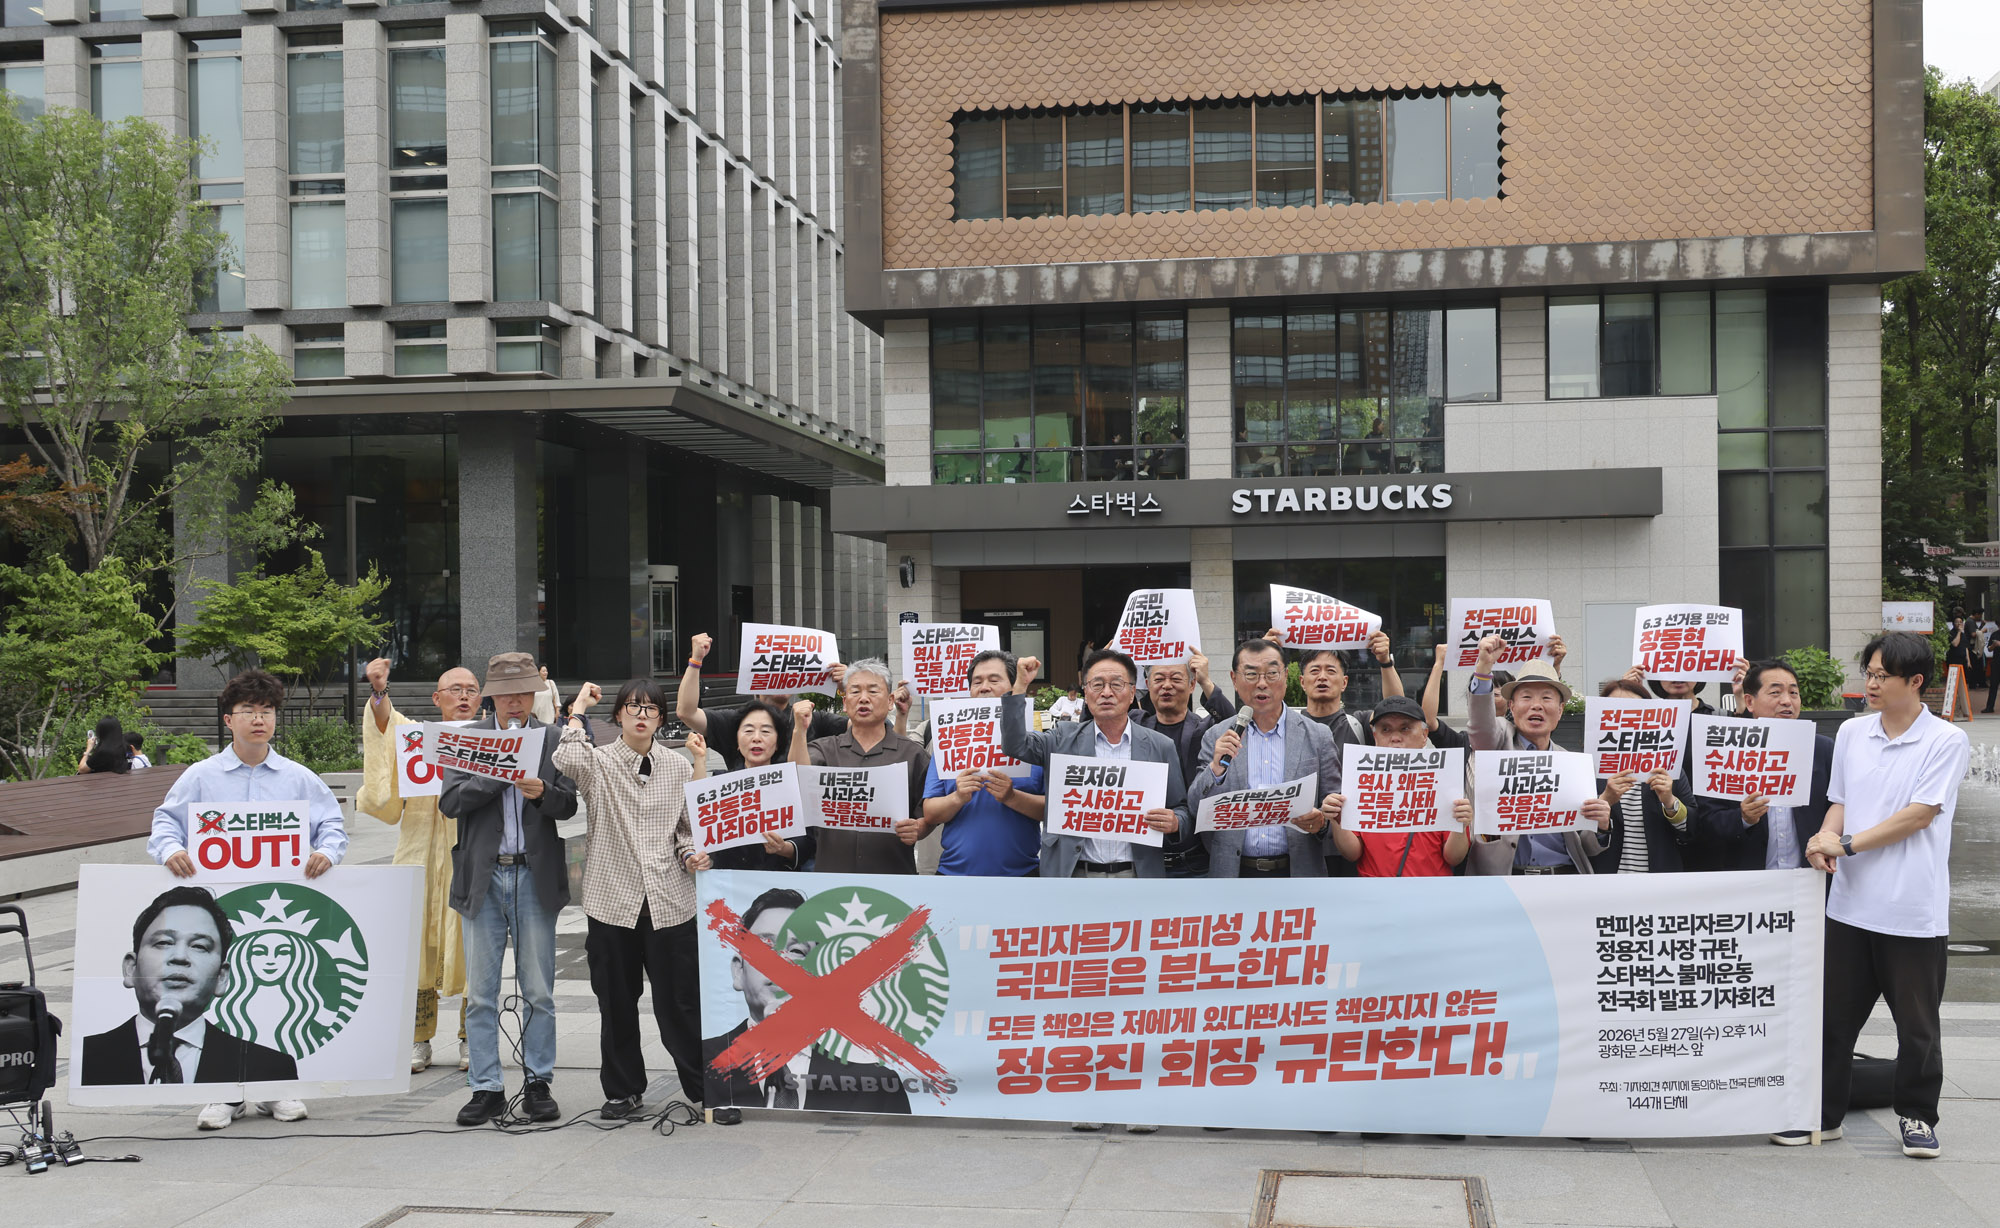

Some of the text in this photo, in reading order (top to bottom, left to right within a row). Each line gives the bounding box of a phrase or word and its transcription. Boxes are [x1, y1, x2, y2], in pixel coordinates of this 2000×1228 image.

[1067, 491, 1162, 515] 스타벅스
[1231, 484, 1453, 514] STARBUCKS
[1127, 593, 1164, 611] 대국민
[1123, 609, 1170, 627] 사과쇼!
[1284, 605, 1359, 623] 수사하고
[1463, 605, 1537, 630] 전국민이
[1642, 612, 1730, 630] 6.3 선거용 망언
[754, 634, 822, 653] 전국민이
[912, 626, 984, 645] 스타벅스의
[1119, 627, 1162, 645] 정용진
[1285, 622, 1368, 645] 처벌하라!
[1639, 626, 1706, 652] 장동혁
[750, 654, 822, 673] 스타벅스
[913, 645, 941, 663] 역사
[1457, 645, 1544, 667] 불하자!
[1642, 649, 1735, 673] 사죄하라!
[750, 671, 830, 691] 불매하자!
[914, 661, 943, 679] 모독
[937, 712, 954, 726] 6.3
[956, 706, 991, 723] 선거용
[1599, 707, 1678, 731] 전국민이
[438, 731, 523, 754] 전국민이
[937, 721, 994, 750] 장동혁
[1596, 729, 1675, 752] 스타벅스
[1705, 725, 1770, 749] 철저히
[435, 745, 518, 769] 스타벅스
[1356, 750, 1447, 772] 스타벅스의
[1498, 755, 1553, 776] 대국민
[1598, 749, 1678, 774] 불매하자!
[1704, 749, 1790, 773] 수사하고
[819, 770, 869, 787] 대국민
[1064, 764, 1127, 788] 철저히
[1357, 773, 1393, 792] 역사
[1499, 774, 1560, 795] 사과쇼!
[1706, 771, 1797, 796] 처벌하라!
[696, 770, 783, 805] 6.3 선거용 망언
[821, 787, 875, 802] 사과쇼!
[1213, 783, 1302, 806] 스타벅스의
[698, 789, 761, 828] 장동혁
[821, 800, 868, 815] 정용진
[1061, 788, 1144, 811] 수사하고
[1213, 802, 1250, 813] 역사
[1357, 790, 1436, 810] 모독 사태
[1496, 793, 1552, 814] 정용진
[227, 811, 300, 832] 스타벅스
[703, 805, 793, 848] 사죄하라!
[823, 813, 892, 829] 규탄한다!
[1212, 810, 1291, 822] 모독 사태
[1358, 808, 1438, 829] 규탄한다!
[1497, 810, 1577, 832] 규탄한다!
[197, 833, 301, 871] OUT!
[1150, 912, 1244, 951] 면피성
[1250, 907, 1317, 943] 사과
[1596, 910, 1796, 938] 면피성 꼬리자르기 사과
[1596, 937, 1744, 962] 정용진 사장 규탄,
[996, 956, 1147, 1001] 국민들은
[1596, 961, 1754, 987] 스타벅스 불매운동
[1597, 985, 1776, 1012] 전국화 발표 기자회견
[1042, 1011, 1115, 1039] 책임은
[1120, 1007, 1197, 1036] 저에게
[1202, 1000, 1328, 1033] 있다면서도
[1335, 992, 1439, 1024] 책임지지
[1444, 989, 1498, 1018] 않는
[1598, 1022, 1767, 1042] 2026년 5월 27일(수) 오후 1시
[0, 1051, 35, 1068] PRO
[1598, 1042, 1704, 1059] 광화문 스타벅스 앞
[996, 1042, 1145, 1095] 정용진
[1158, 1036, 1266, 1088] 회장
[784, 1073, 959, 1095] STARBUCKS
[1623, 1081, 1661, 1093] 기자회견
[1661, 1080, 1690, 1092] 취지에
[1690, 1079, 1728, 1091] 동의하는
[1728, 1077, 1748, 1089] 전국
[1747, 1076, 1766, 1088] 단체
[1766, 1074, 1786, 1087] 연명
[1626, 1095, 1688, 1110] 144개 단체
